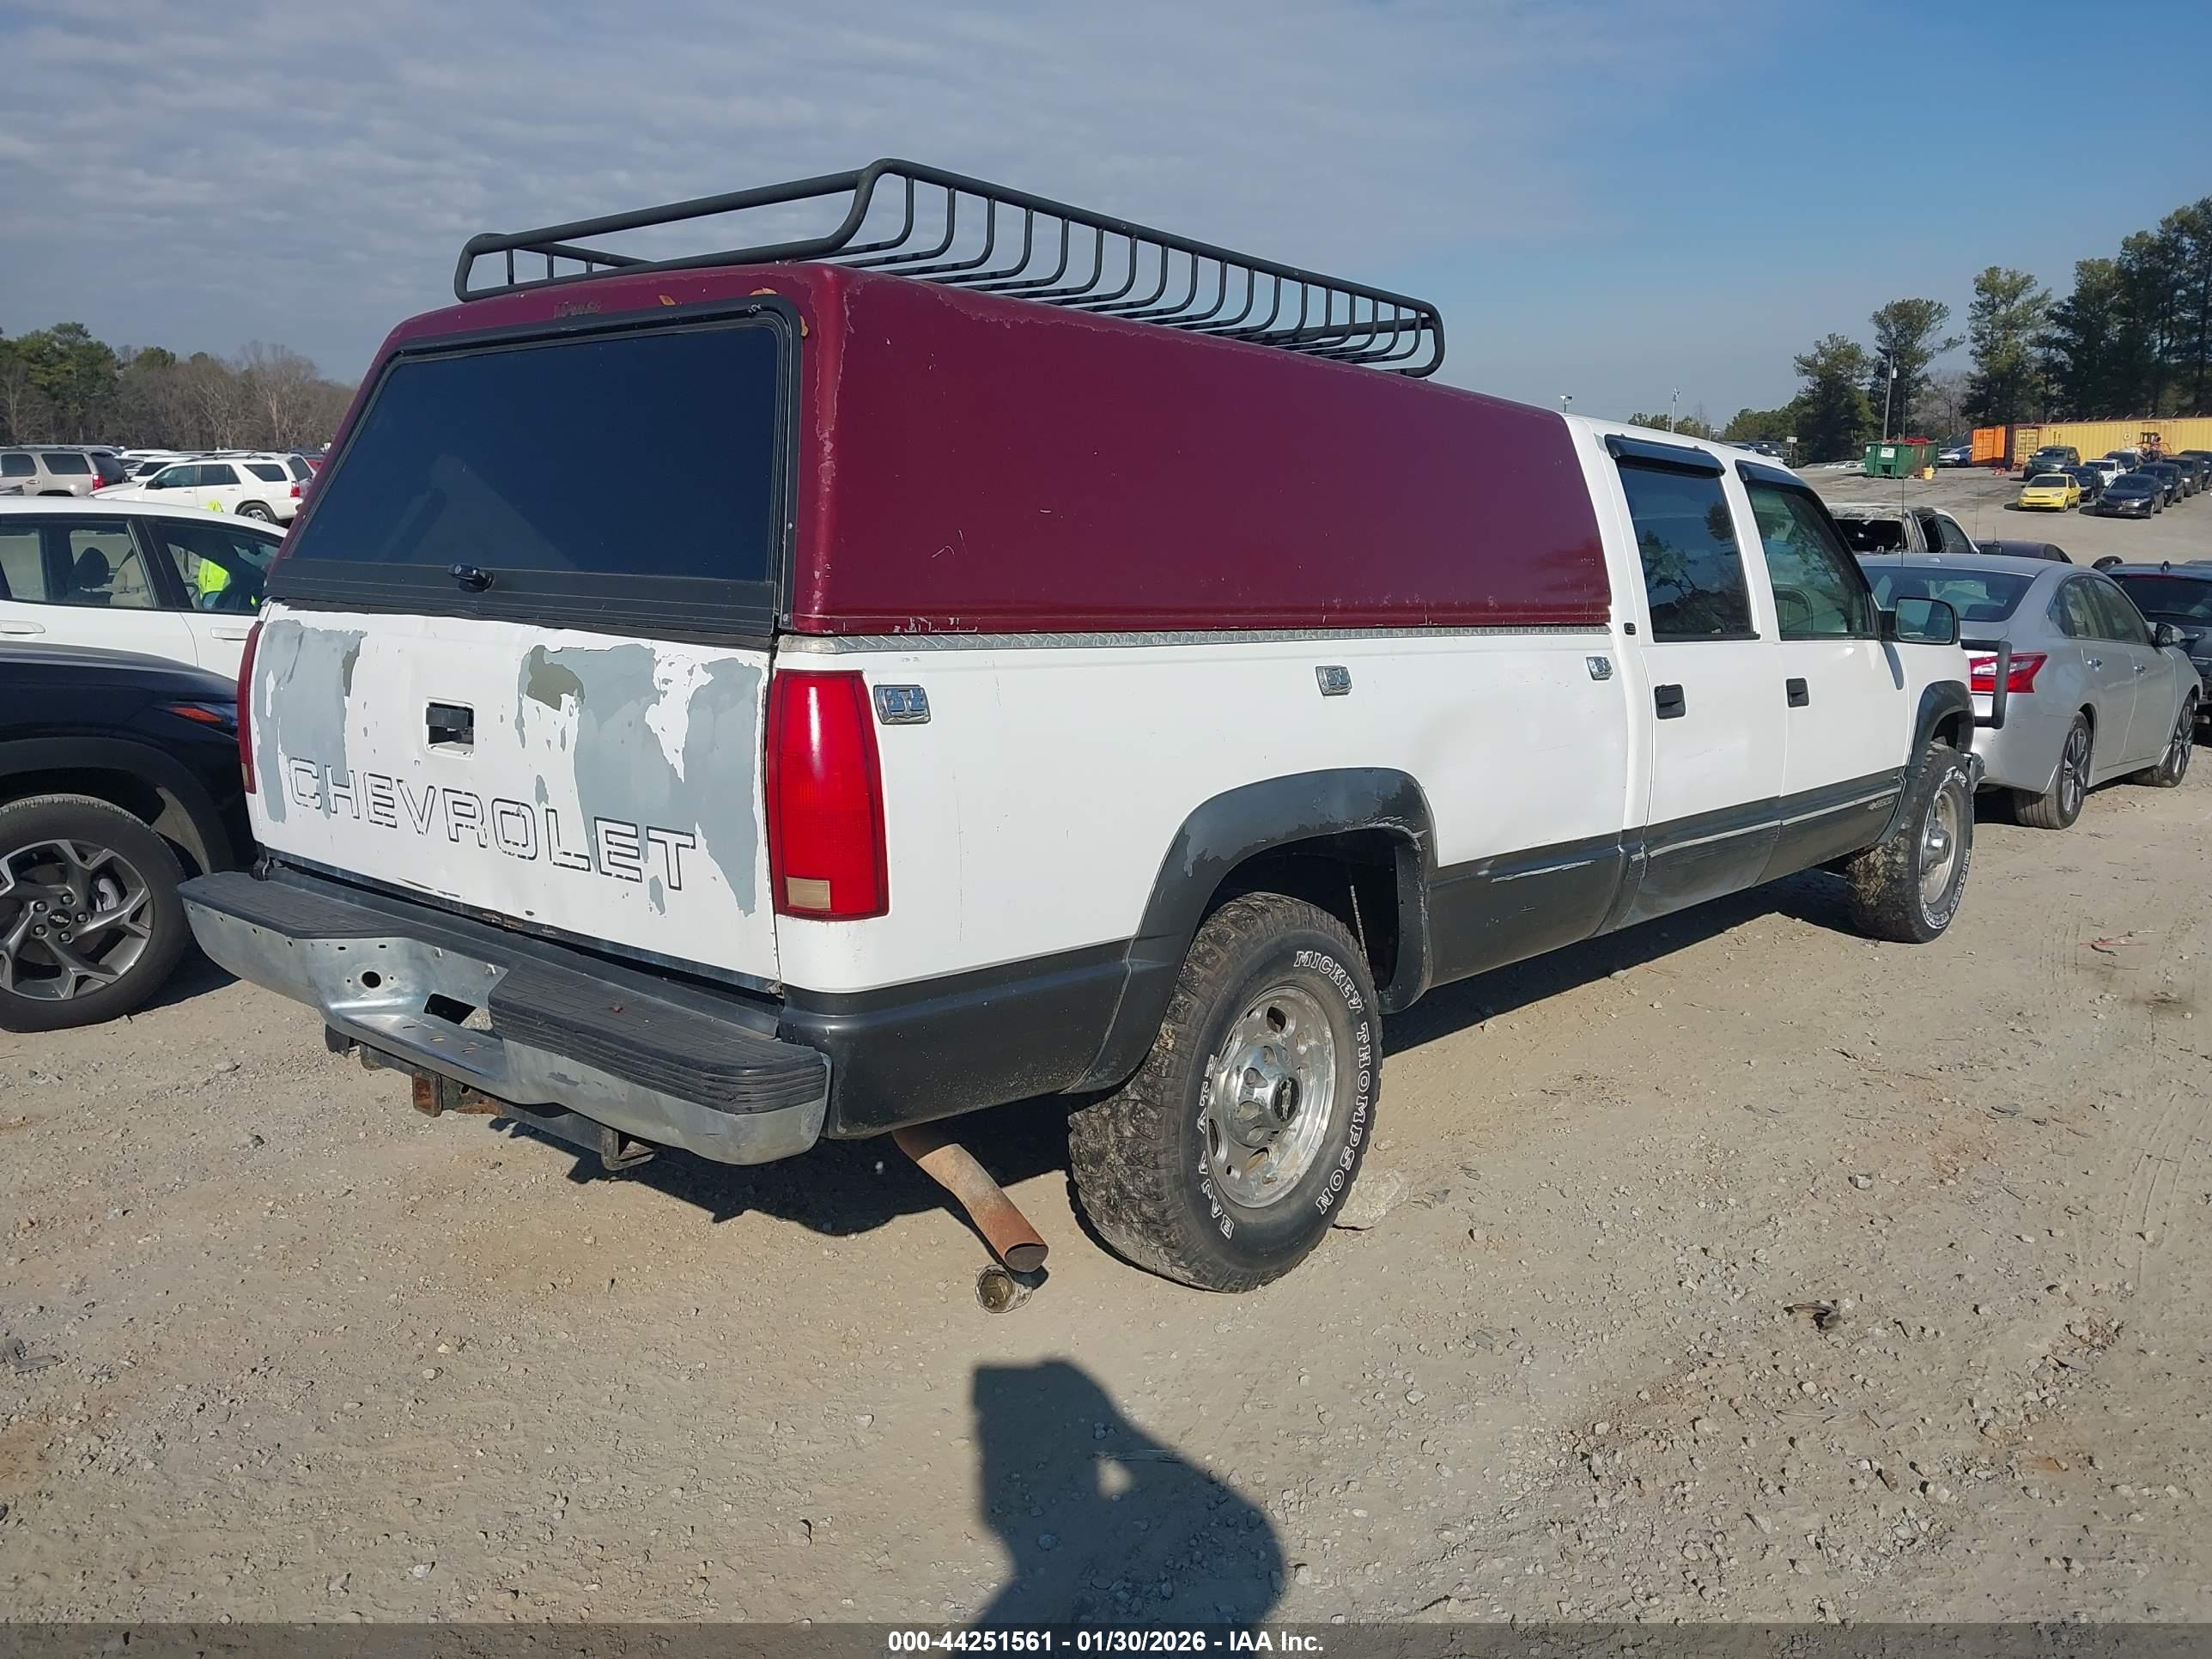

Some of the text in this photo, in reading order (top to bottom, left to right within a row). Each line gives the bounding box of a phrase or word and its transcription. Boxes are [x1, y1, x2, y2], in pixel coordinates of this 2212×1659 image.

[289, 757, 697, 891] CHEVROLET
[1293, 951, 1371, 1216] MICKEY THOMPSON
[1199, 1150, 1235, 1240] BAJA
